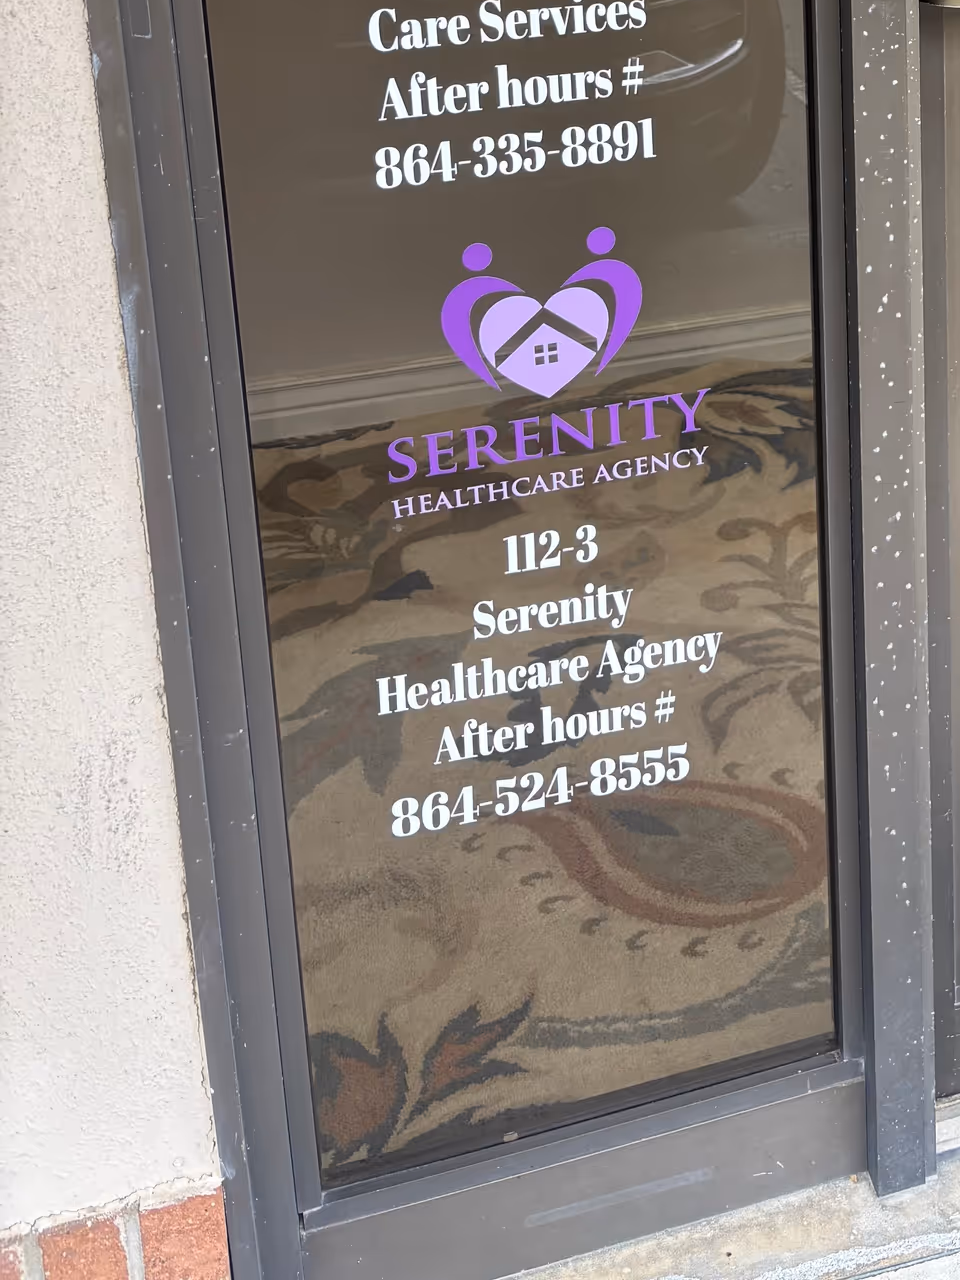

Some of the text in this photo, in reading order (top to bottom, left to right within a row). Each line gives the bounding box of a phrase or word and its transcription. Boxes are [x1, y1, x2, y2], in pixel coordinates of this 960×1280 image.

[368, 8, 471, 52] Care
[378, 57, 645, 121] After hours #
[374, 118, 657, 189] 864-335-8891
[387, 387, 711, 484] SERENITY
[391, 445, 709, 519] HEALTHCARE AGENCY
[503, 524, 599, 575] 112-3
[473, 582, 634, 640] Serenity
[376, 631, 724, 716] Healthcare Agency
[434, 689, 676, 765] After hours #
[391, 742, 690, 838] 864-524-8555
